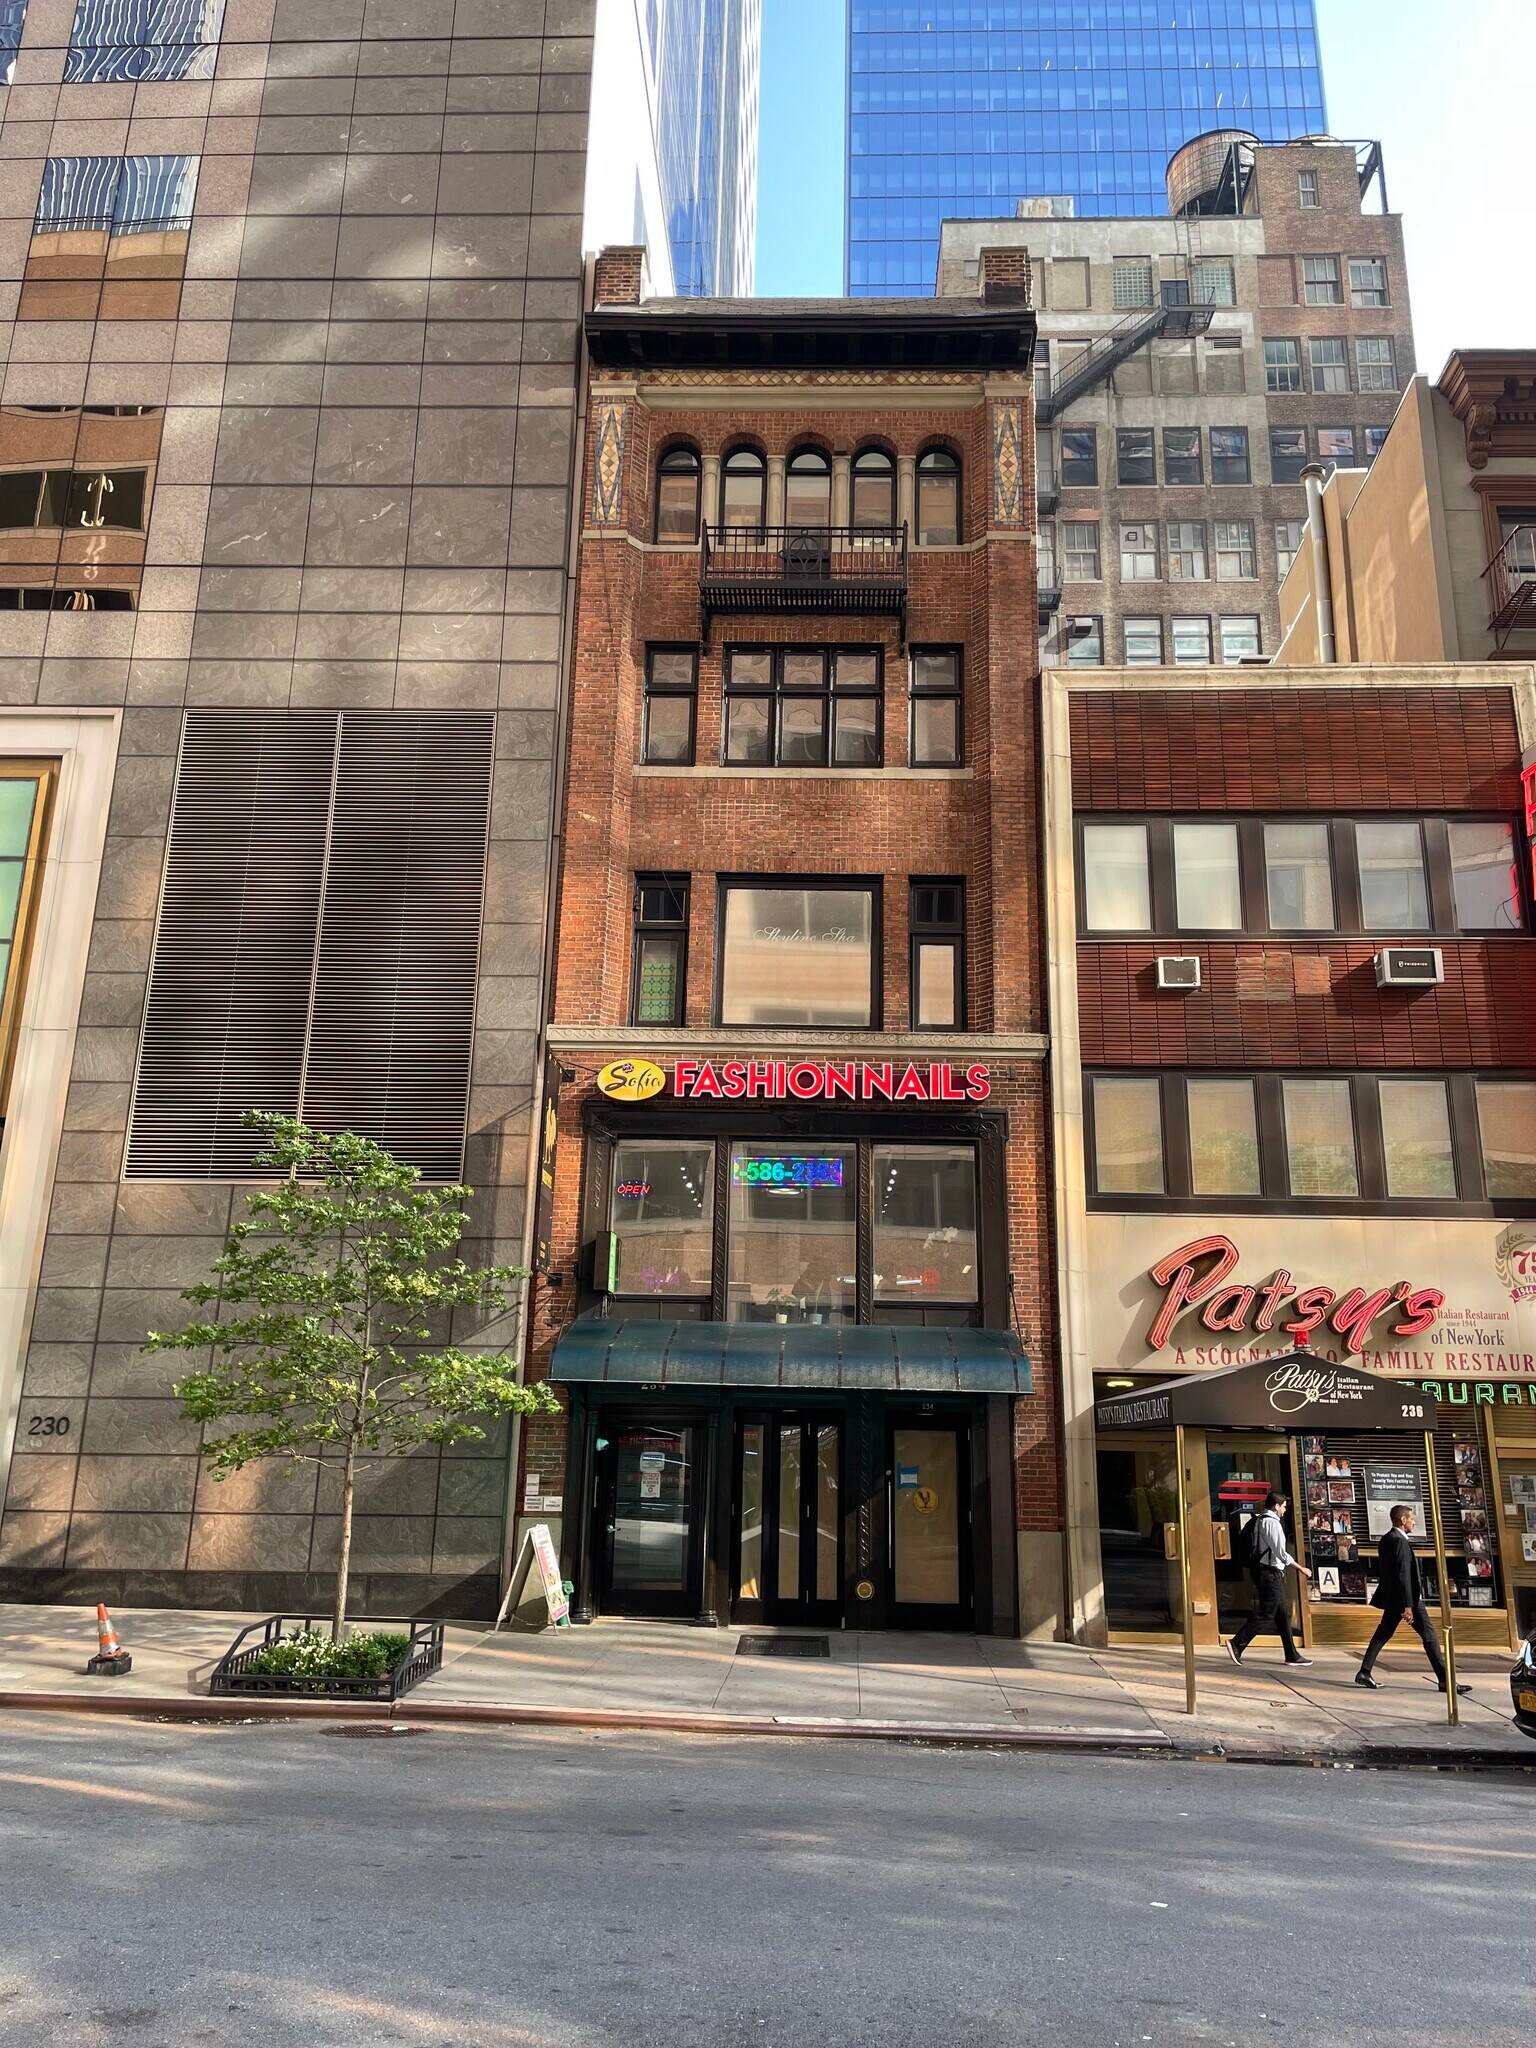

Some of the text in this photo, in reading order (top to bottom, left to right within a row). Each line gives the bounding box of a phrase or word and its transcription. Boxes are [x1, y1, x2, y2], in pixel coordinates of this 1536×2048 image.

[754, 926, 856, 943] Skyline Spa
[674, 1059, 991, 1101] FASHION NAILS
[617, 1185, 650, 1194] OPEN
[1146, 1234, 1446, 1354] Patsy's
[1437, 1308, 1510, 1321] Italian Restaurant
[1431, 1328, 1505, 1346] of New York
[1174, 1347, 1186, 1364] A
[1361, 1350, 1434, 1369] FAMILY
[1264, 1363, 1338, 1398] Patsy's
[1330, 1390, 1363, 1400] of New York
[1402, 1404, 1424, 1418] 236
[28, 1416, 70, 1436] 230
[1323, 1570, 1335, 1586] A
